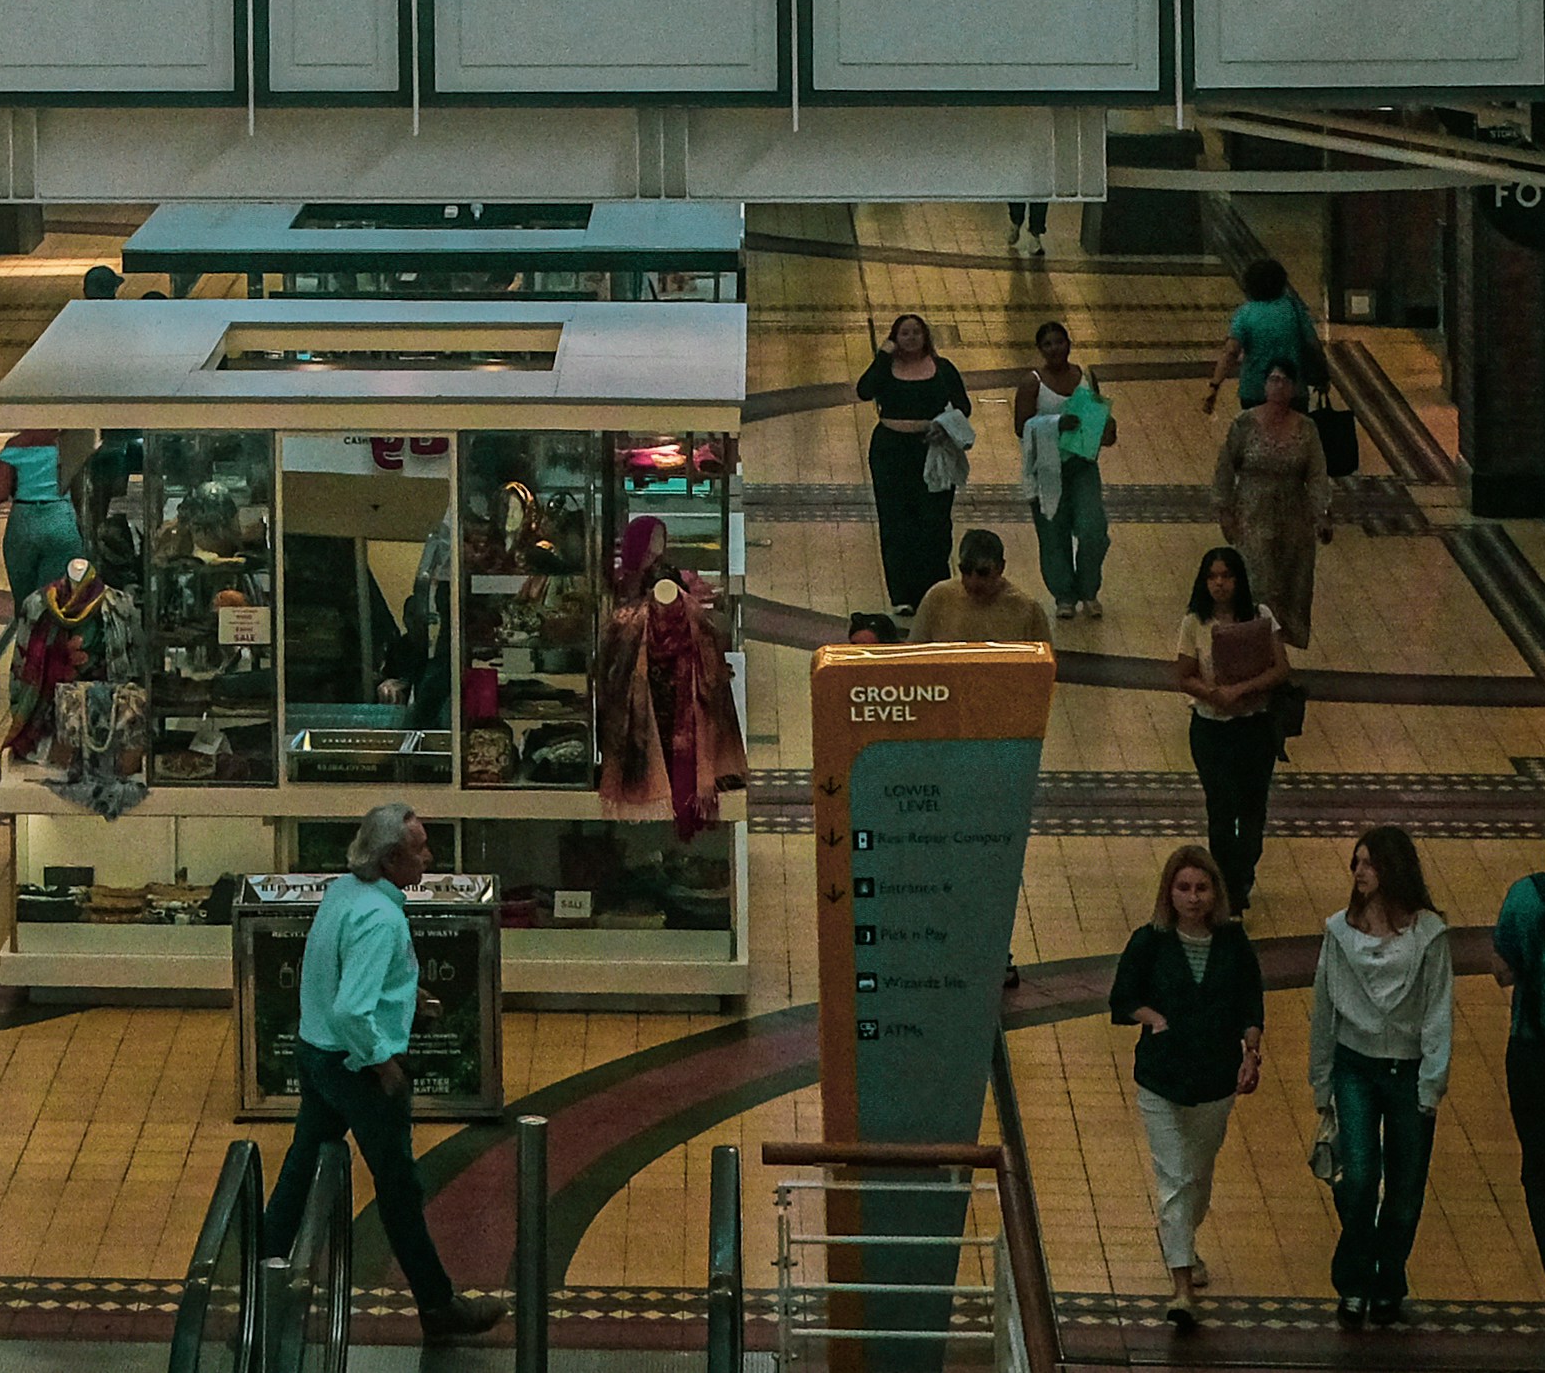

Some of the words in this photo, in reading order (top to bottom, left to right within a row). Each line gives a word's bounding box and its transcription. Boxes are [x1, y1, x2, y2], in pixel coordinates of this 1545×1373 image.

[849, 686, 950, 703] GROUND
[851, 706, 917, 722] LEVEL
[884, 784, 941, 798] LOWER
[898, 800, 941, 813] LEVEL
[953, 831, 1012, 846] Company
[880, 882, 937, 894] Entrance
[881, 928, 907, 941] Pick
[925, 927, 947, 943] Pay
[883, 1024, 923, 1038] ATMs
